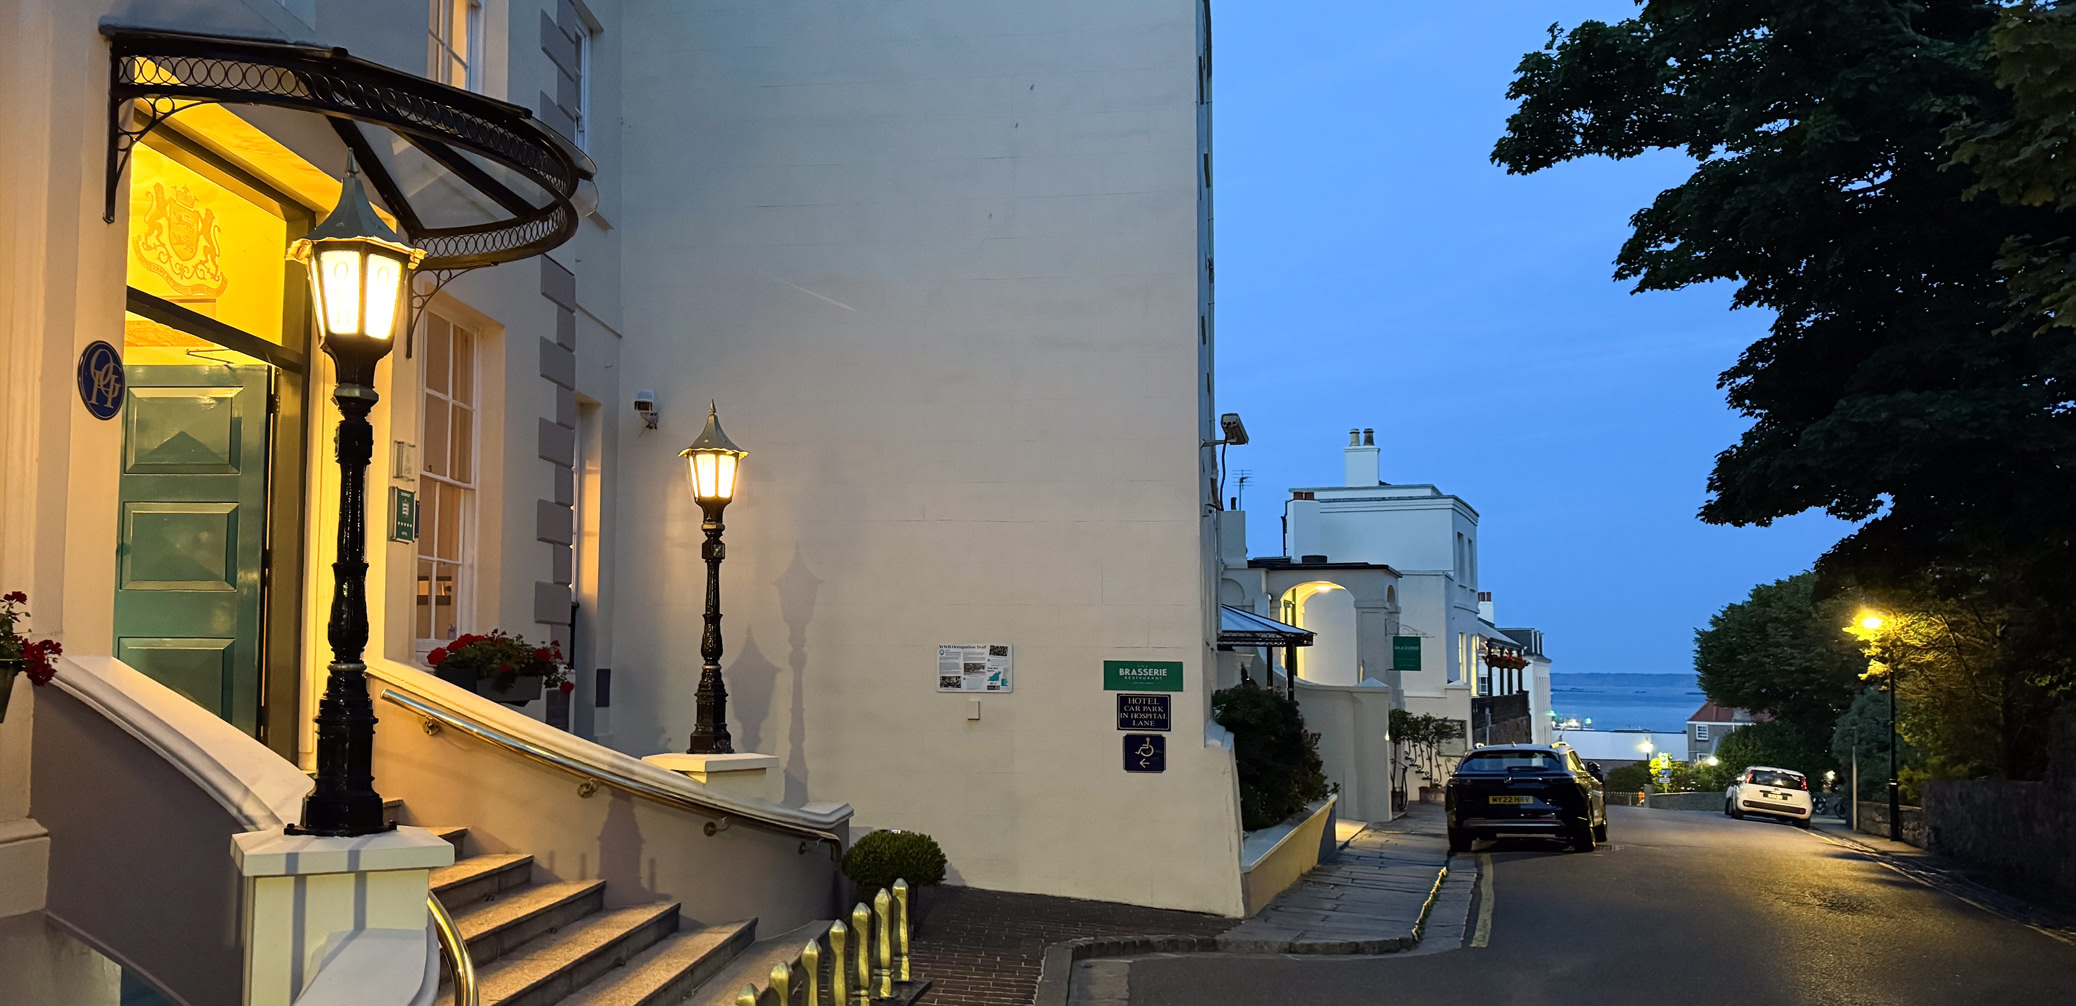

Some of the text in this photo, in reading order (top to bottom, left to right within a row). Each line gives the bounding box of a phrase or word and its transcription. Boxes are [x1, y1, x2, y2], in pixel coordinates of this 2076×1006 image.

[1119, 668, 1168, 676] BRASSERIE
[1128, 697, 1160, 705] HOTEL
[1131, 712, 1168, 720] HOSPITAL
[1132, 719, 1155, 727] LANE
